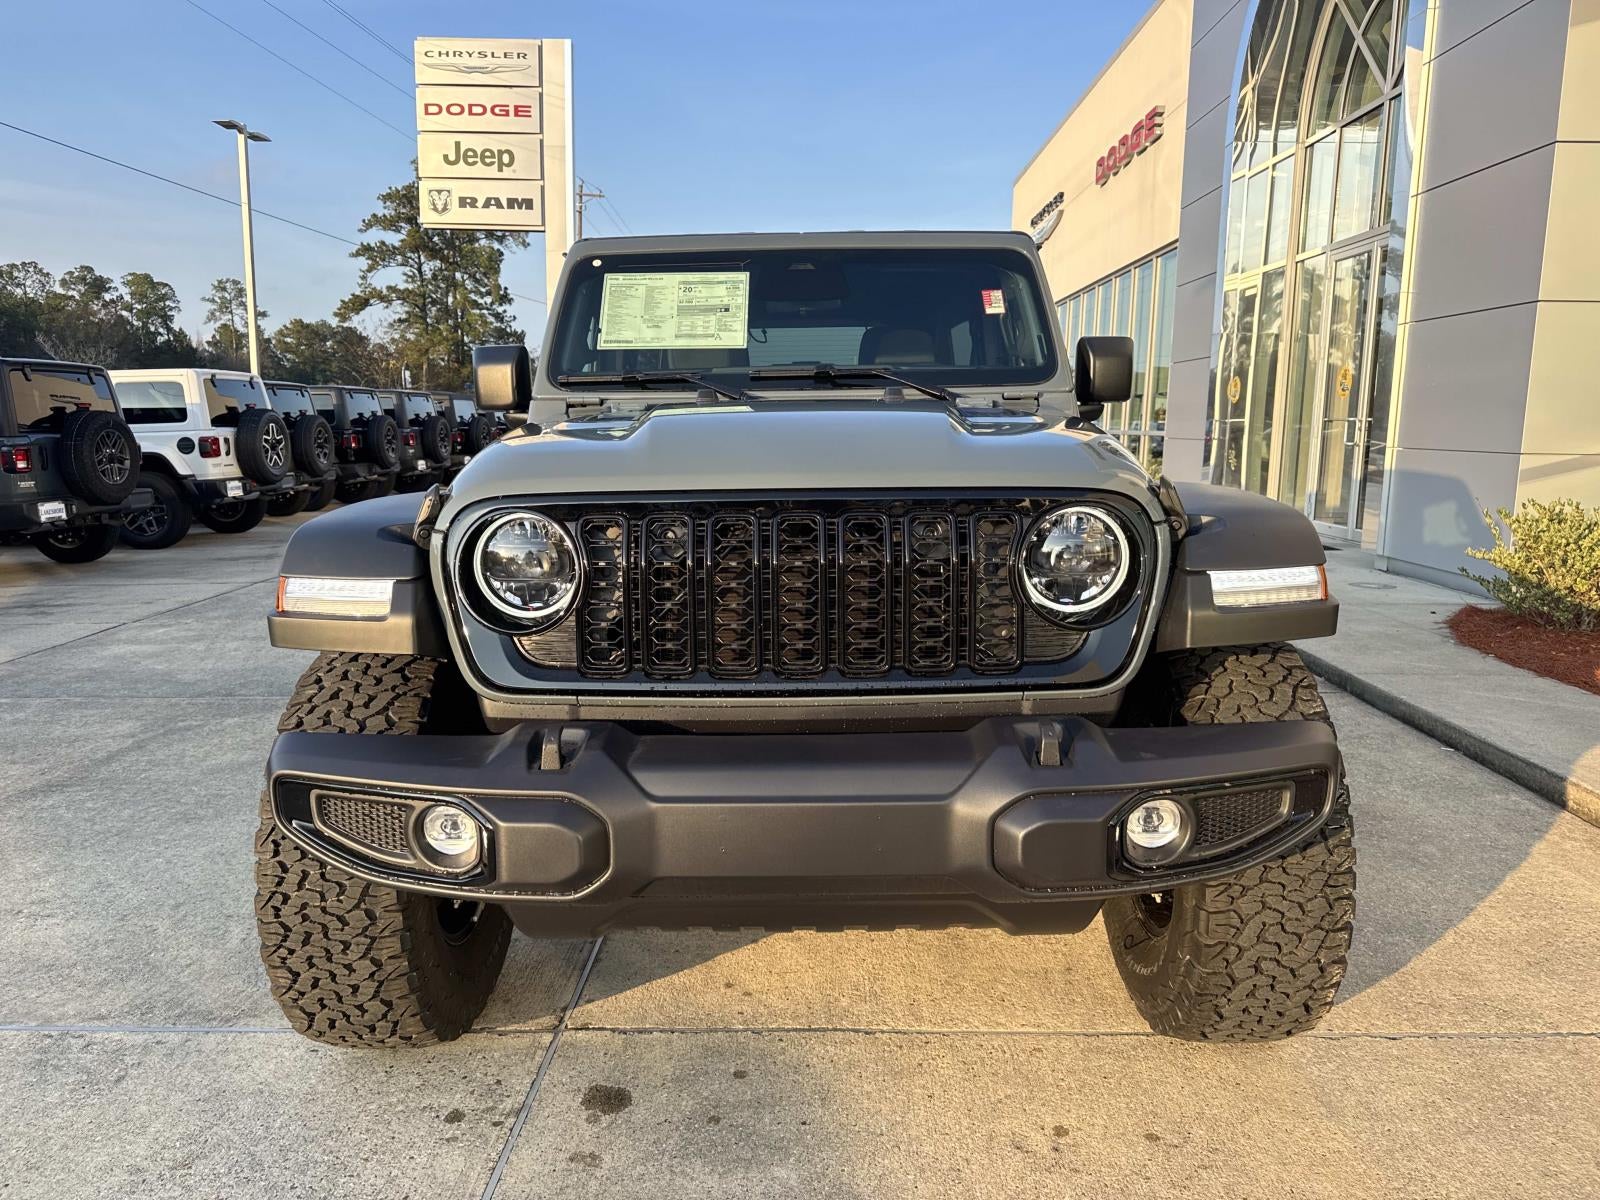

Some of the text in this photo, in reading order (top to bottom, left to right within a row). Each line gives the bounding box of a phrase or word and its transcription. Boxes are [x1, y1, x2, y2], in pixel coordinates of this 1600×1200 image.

[424, 50, 528, 60] CHRYSLER
[424, 103, 532, 118] DODGE
[1095, 105, 1166, 187] DODGE
[443, 141, 515, 172] Jeep
[458, 196, 534, 211] RAM
